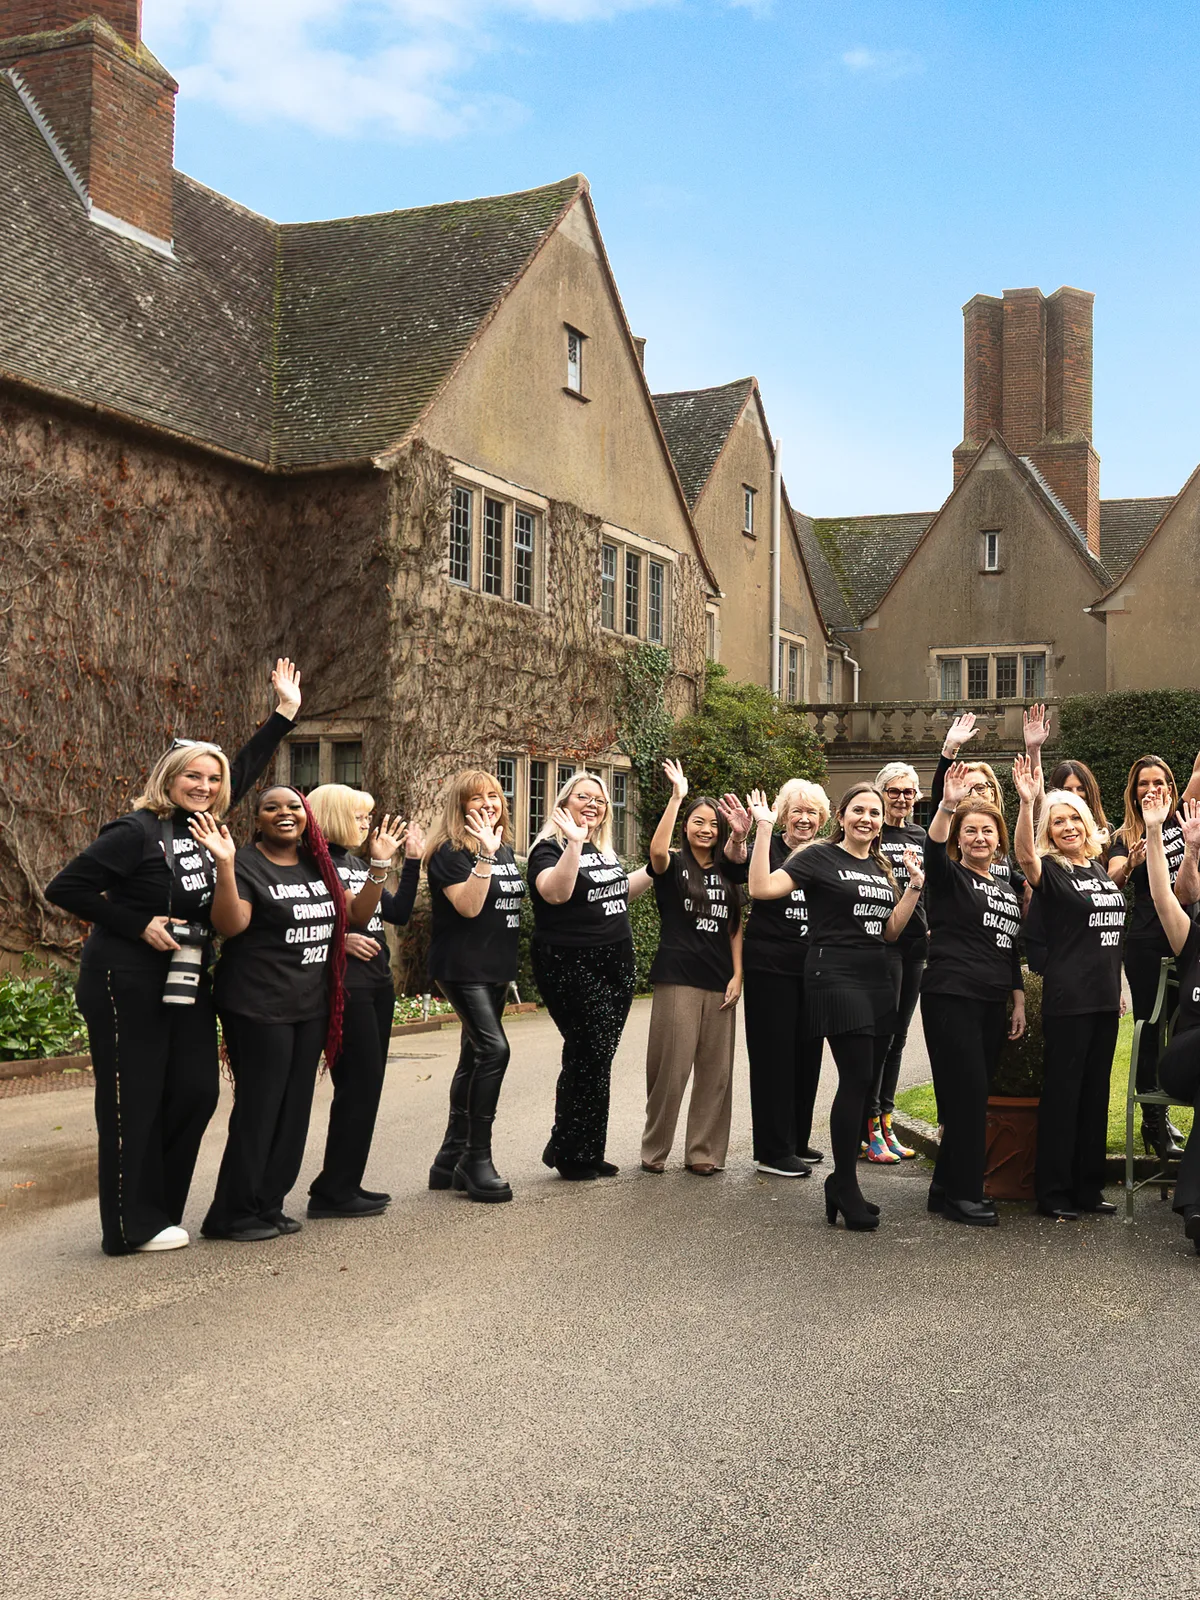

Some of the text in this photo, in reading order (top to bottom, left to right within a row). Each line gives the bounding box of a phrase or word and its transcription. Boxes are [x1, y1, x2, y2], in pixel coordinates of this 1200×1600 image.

[308, 880, 329, 896] FIR
[602, 899, 627, 916] 2027
[684, 898, 728, 918] CDAR
[853, 903, 893, 919] CALENDA
[864, 921, 882, 935] 2027
[983, 912, 1020, 936] CALENDA
[285, 923, 334, 944] CALEND
[996, 933, 1012, 949] 202
[1100, 931, 1120, 946] 2027
[301, 944, 329, 965] 2027
